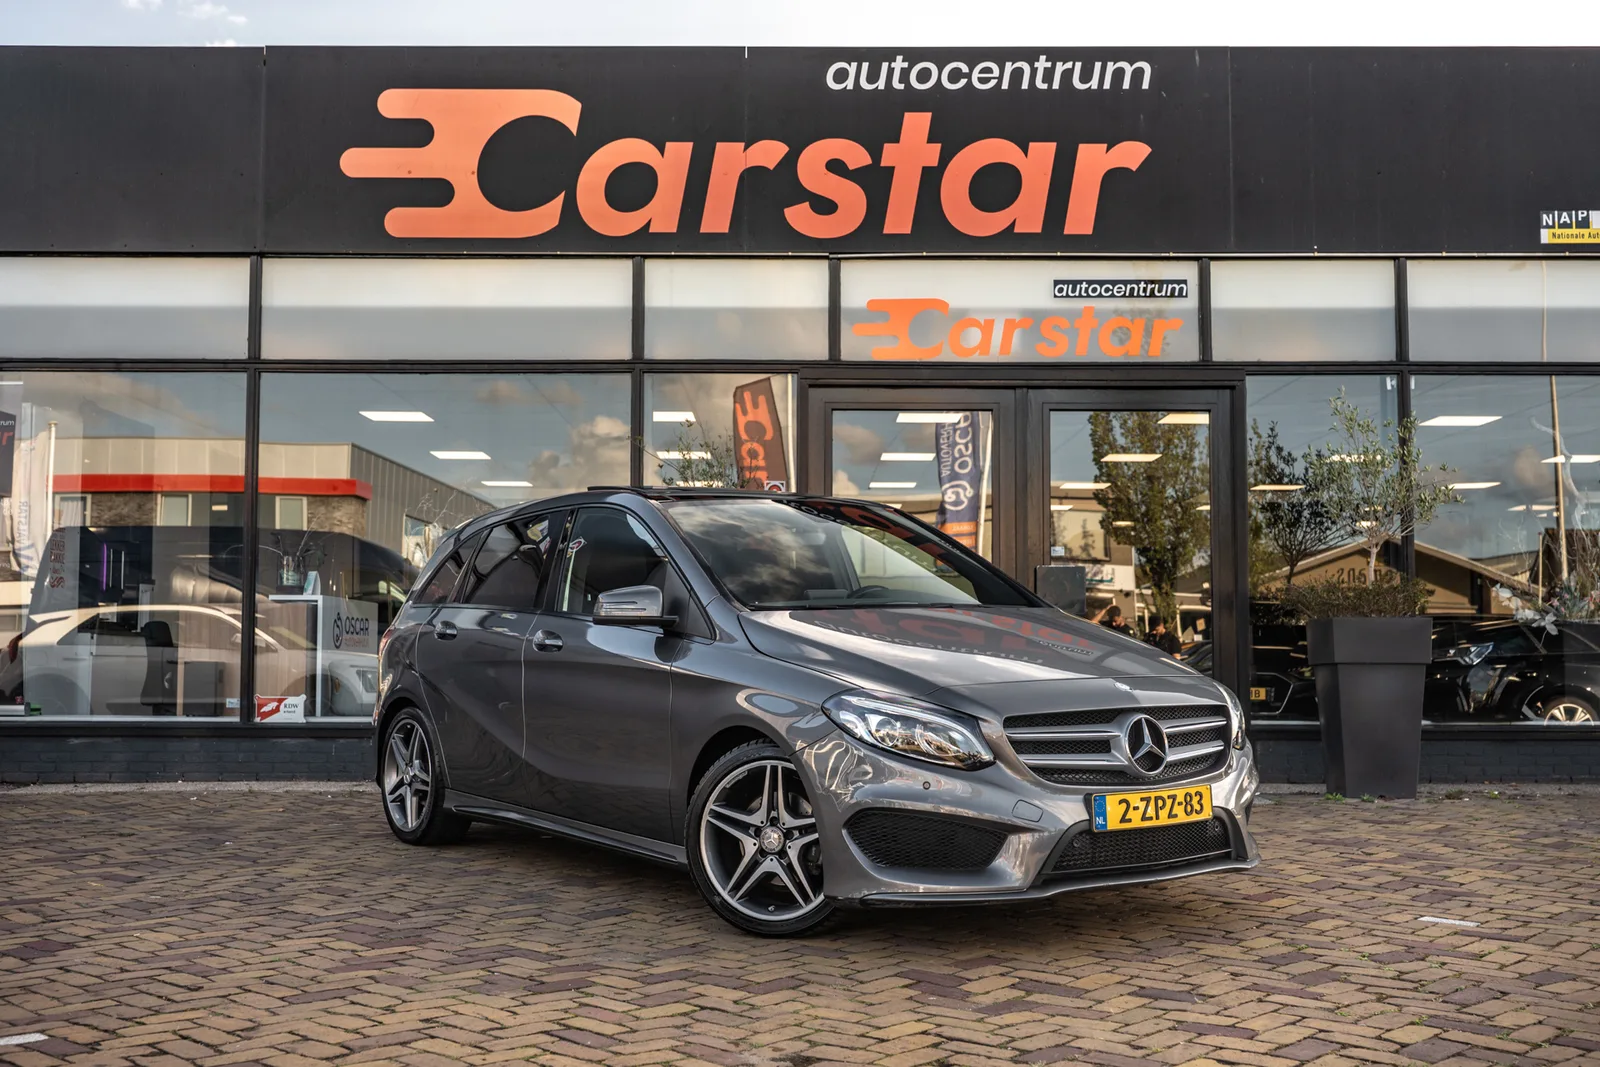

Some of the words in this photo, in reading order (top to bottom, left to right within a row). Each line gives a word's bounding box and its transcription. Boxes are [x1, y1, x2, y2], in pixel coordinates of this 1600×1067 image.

[825, 54, 1152, 91] autocentrum
[339, 88, 1152, 239] Carstar
[1054, 281, 1187, 297] autocentrum
[852, 297, 1184, 360] Carstar
[344, 616, 369, 636] OSCAR
[1096, 816, 1106, 825] NL
[1118, 791, 1204, 824] 2-ZPZ-83
